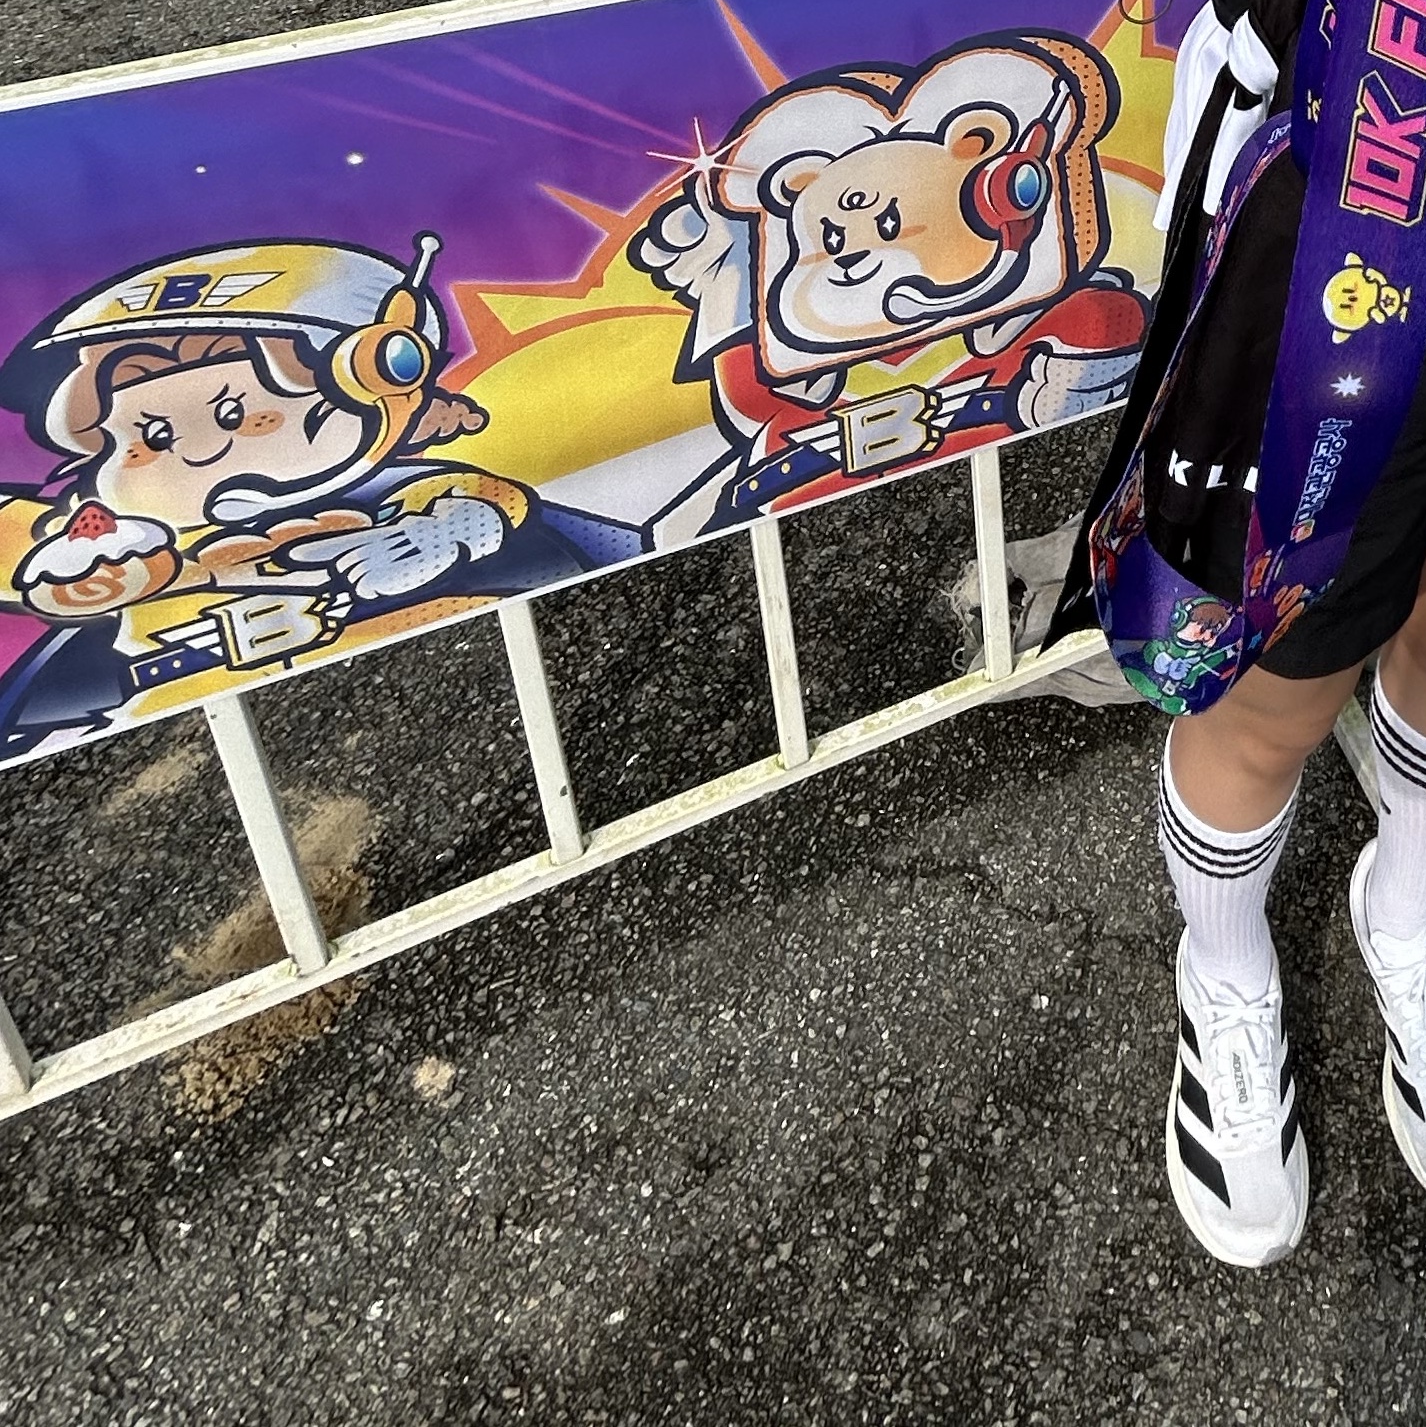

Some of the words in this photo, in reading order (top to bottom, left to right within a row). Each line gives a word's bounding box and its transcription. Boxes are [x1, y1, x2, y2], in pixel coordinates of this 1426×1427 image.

[154, 274, 212, 311] B
[834, 387, 938, 474] B
[206, 593, 336, 669] B
[1232, 1051, 1249, 1105] ADIZERO
